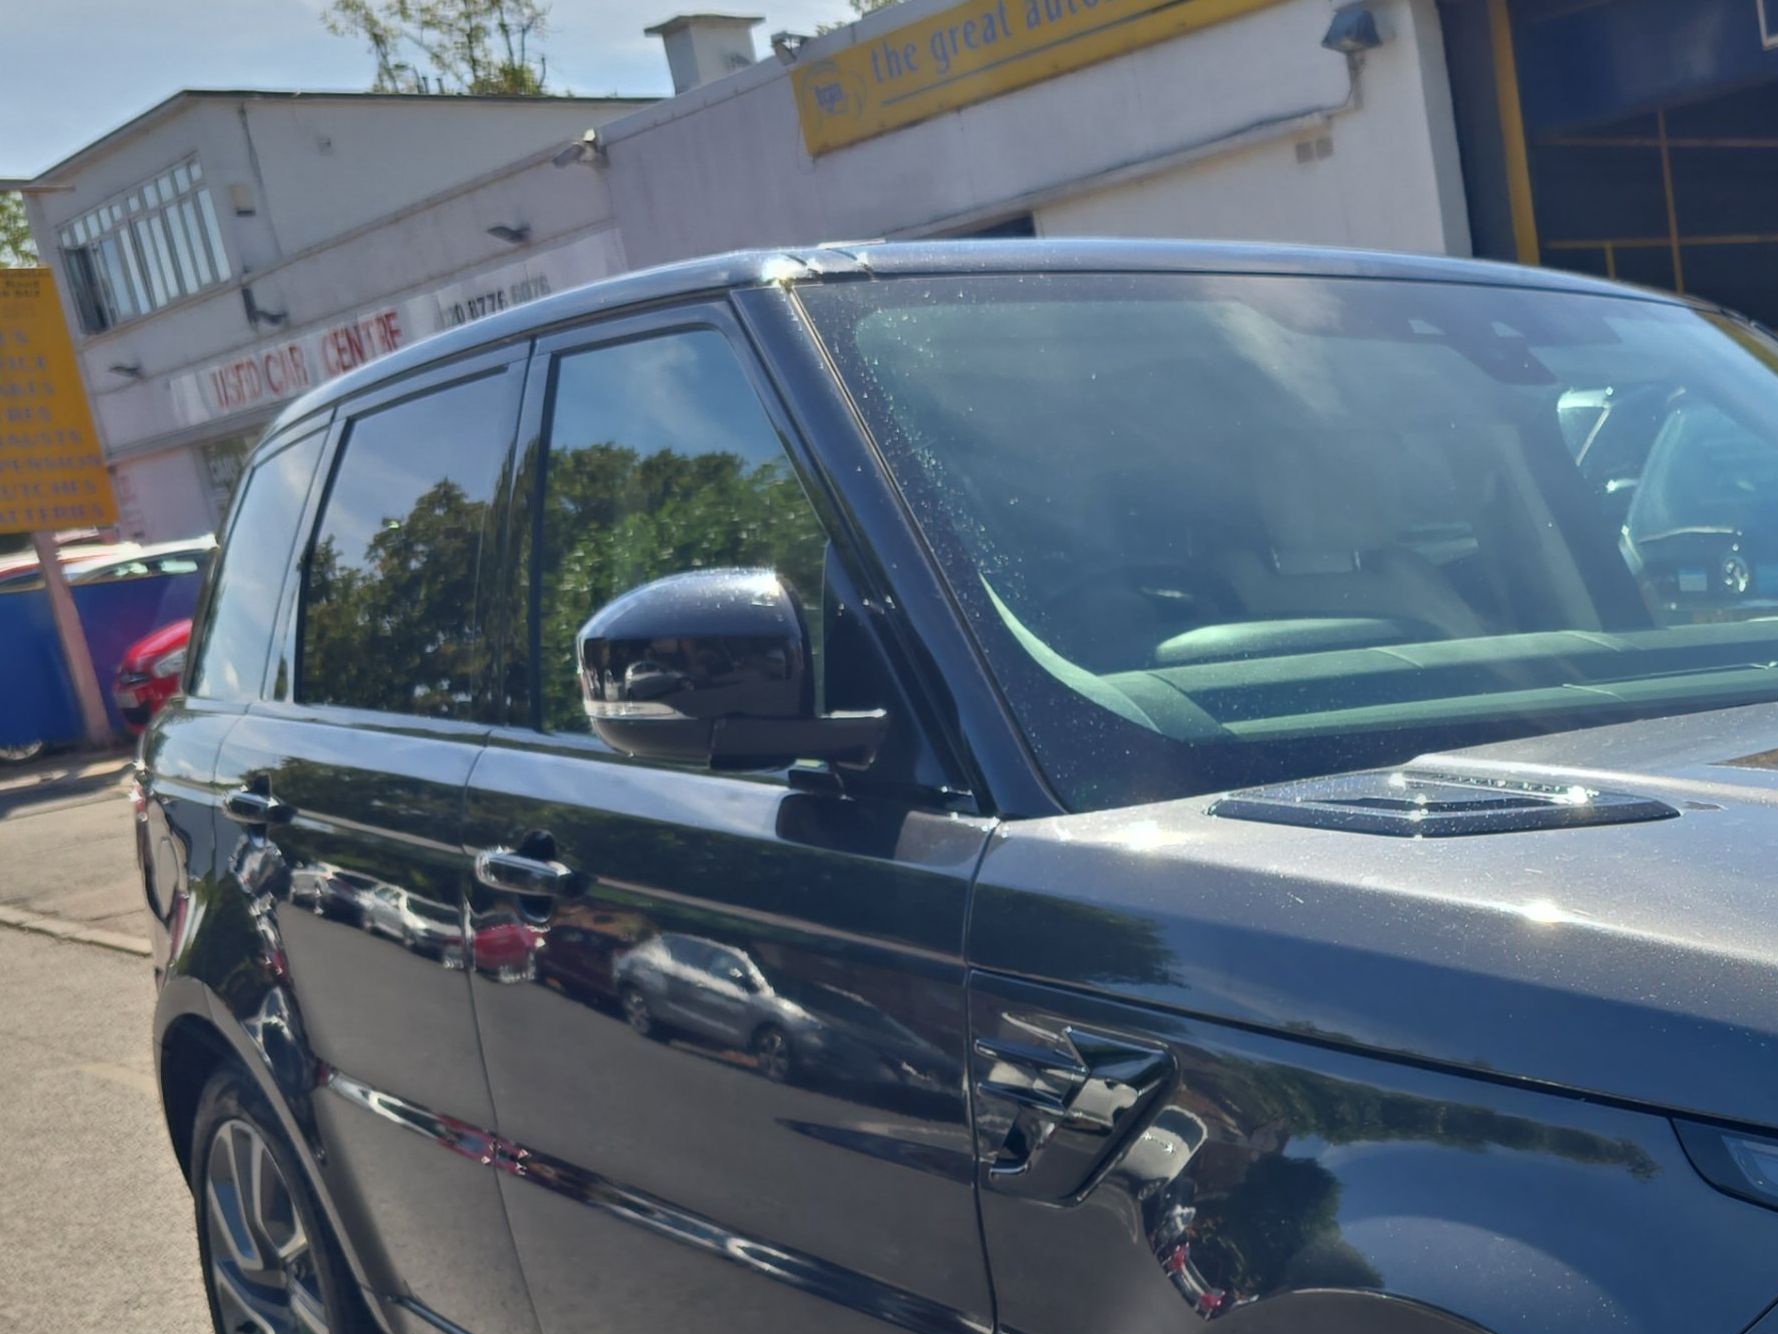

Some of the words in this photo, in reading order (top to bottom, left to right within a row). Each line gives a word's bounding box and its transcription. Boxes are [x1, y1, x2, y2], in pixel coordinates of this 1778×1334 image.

[870, 40, 919, 84] the
[929, 0, 1012, 75] great
[210, 355, 263, 409] USED
[263, 342, 310, 396] CAR
[320, 306, 403, 377] CENTRE
